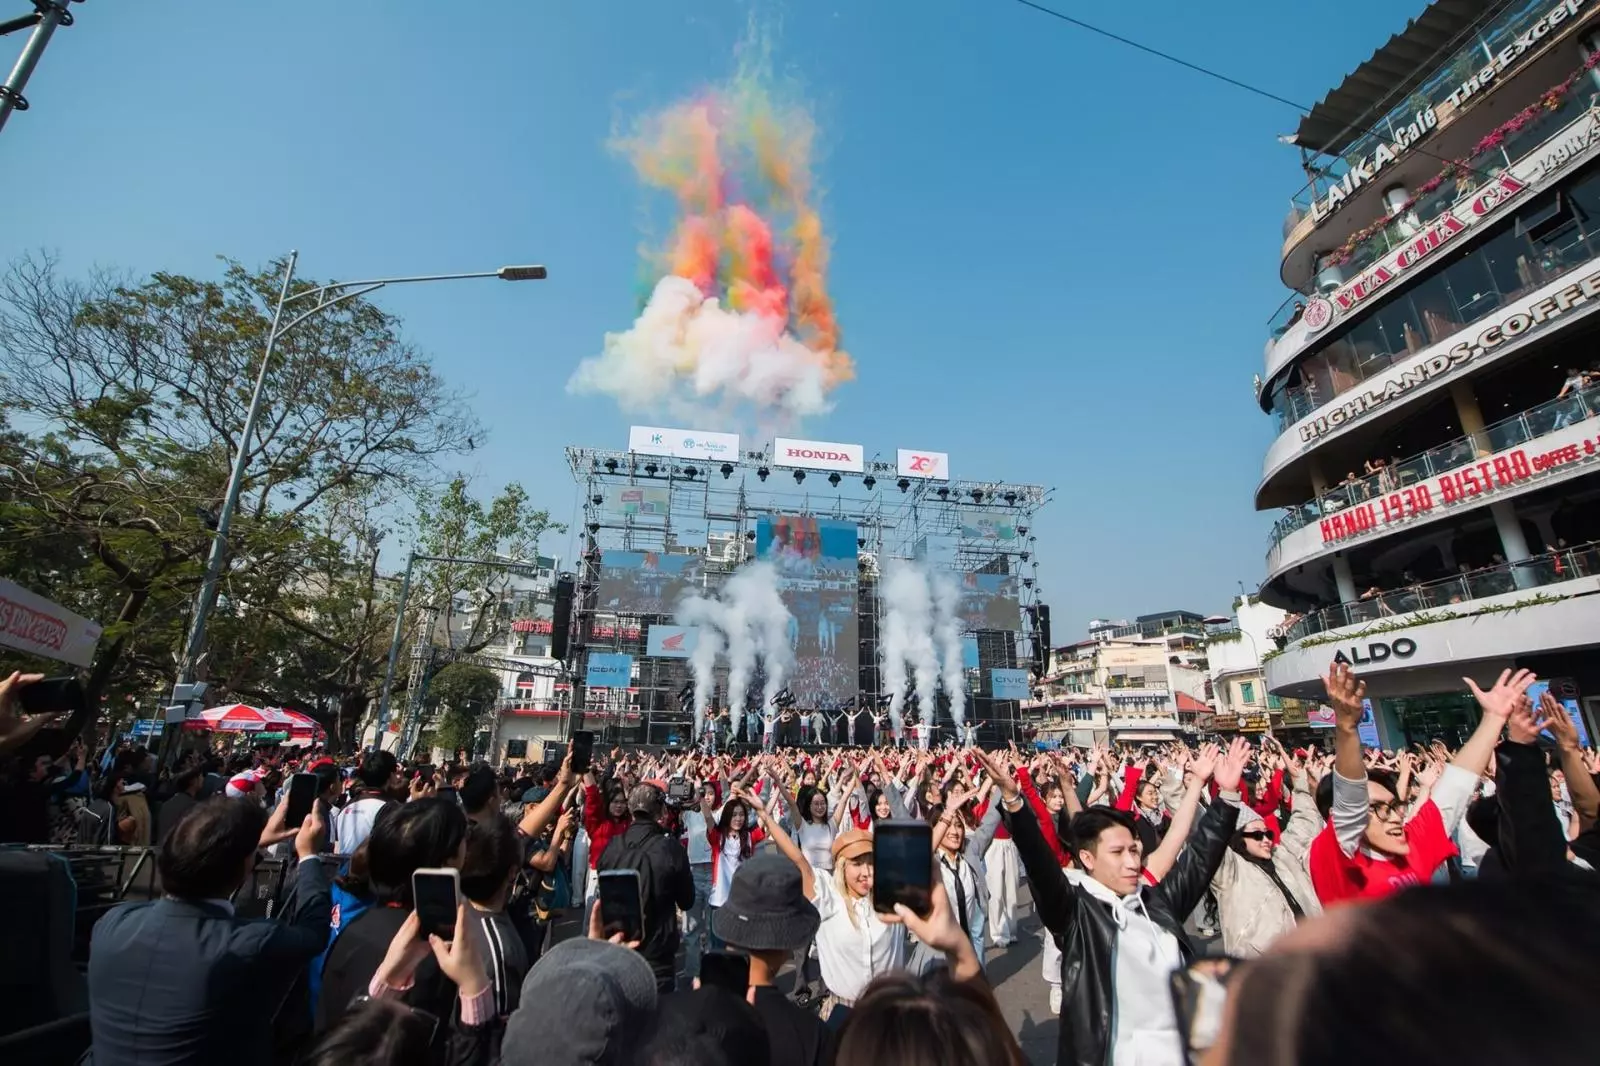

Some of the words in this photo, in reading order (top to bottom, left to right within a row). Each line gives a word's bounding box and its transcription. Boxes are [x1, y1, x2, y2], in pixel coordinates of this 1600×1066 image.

[1446, 66, 1496, 109] The
[1310, 143, 1396, 222] LAIKA
[1394, 102, 1438, 151] Café
[1336, 267, 1394, 311] VUA
[1471, 170, 1528, 218] CÁ
[1299, 342, 1475, 442] HIGHLANDS
[787, 448, 851, 462] HONDA
[1319, 503, 1377, 543] HANOI
[1379, 484, 1434, 522] 1930
[1438, 449, 1533, 505] BISTRO
[995, 676, 1025, 684] CIVIC
[1334, 637, 1417, 665] ALDO
